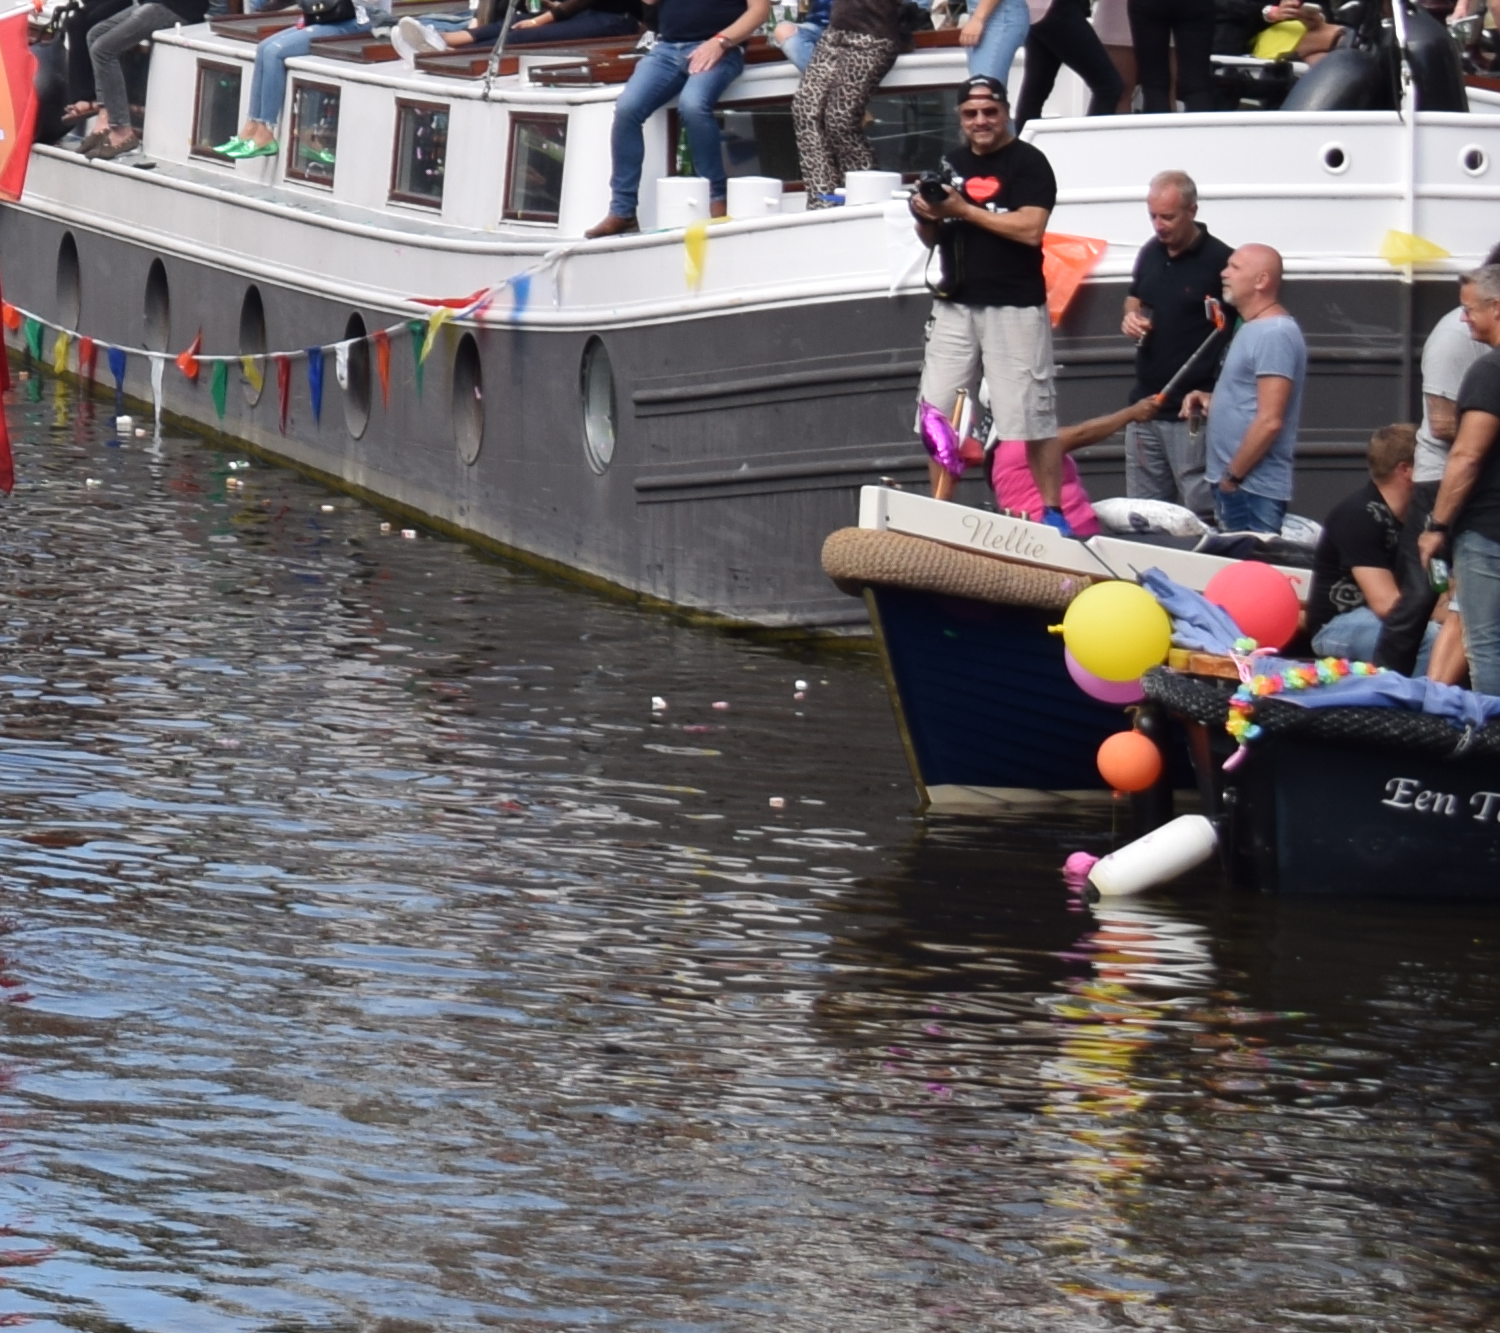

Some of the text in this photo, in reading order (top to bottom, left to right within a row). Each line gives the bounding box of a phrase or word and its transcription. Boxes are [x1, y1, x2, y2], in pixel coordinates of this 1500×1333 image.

[962, 514, 1045, 559] Nellie
[1381, 777, 1500, 823] Een T
